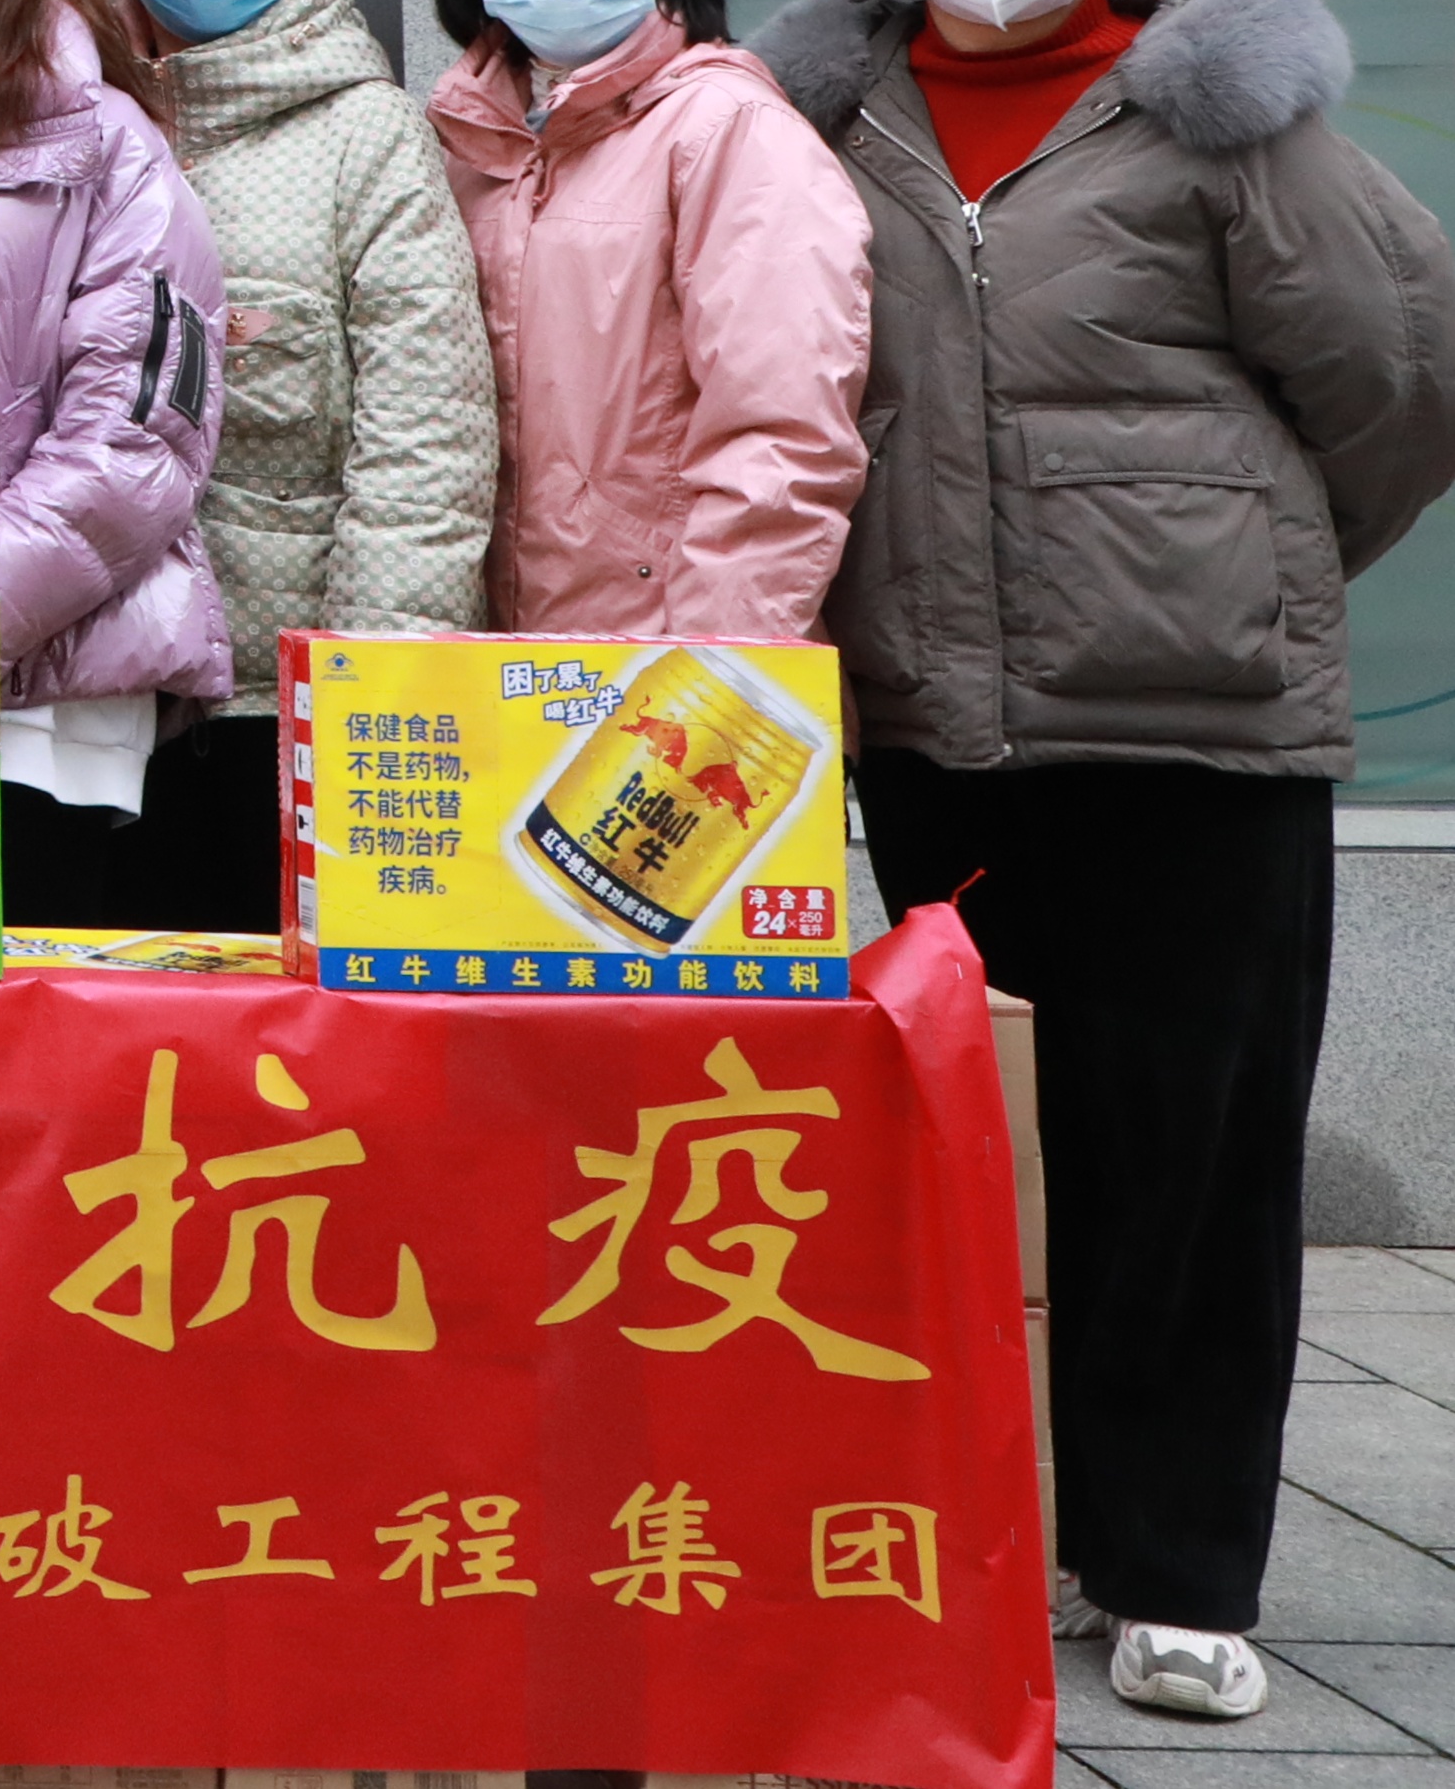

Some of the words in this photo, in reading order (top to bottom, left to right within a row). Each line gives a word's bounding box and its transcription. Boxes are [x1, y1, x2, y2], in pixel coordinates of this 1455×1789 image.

[502, 660, 603, 699] 困了累了
[543, 685, 624, 728] 喝红牛
[345, 712, 460, 744] 保健食品
[347, 789, 462, 820] 不能代替
[347, 827, 463, 857] 药物治疗
[591, 806, 670, 874] 红牛
[539, 827, 670, 934] 红牛维生素功能饮料
[748, 887, 826, 910] 净含量
[345, 953, 821, 993] 红牛维生素功能饮料
